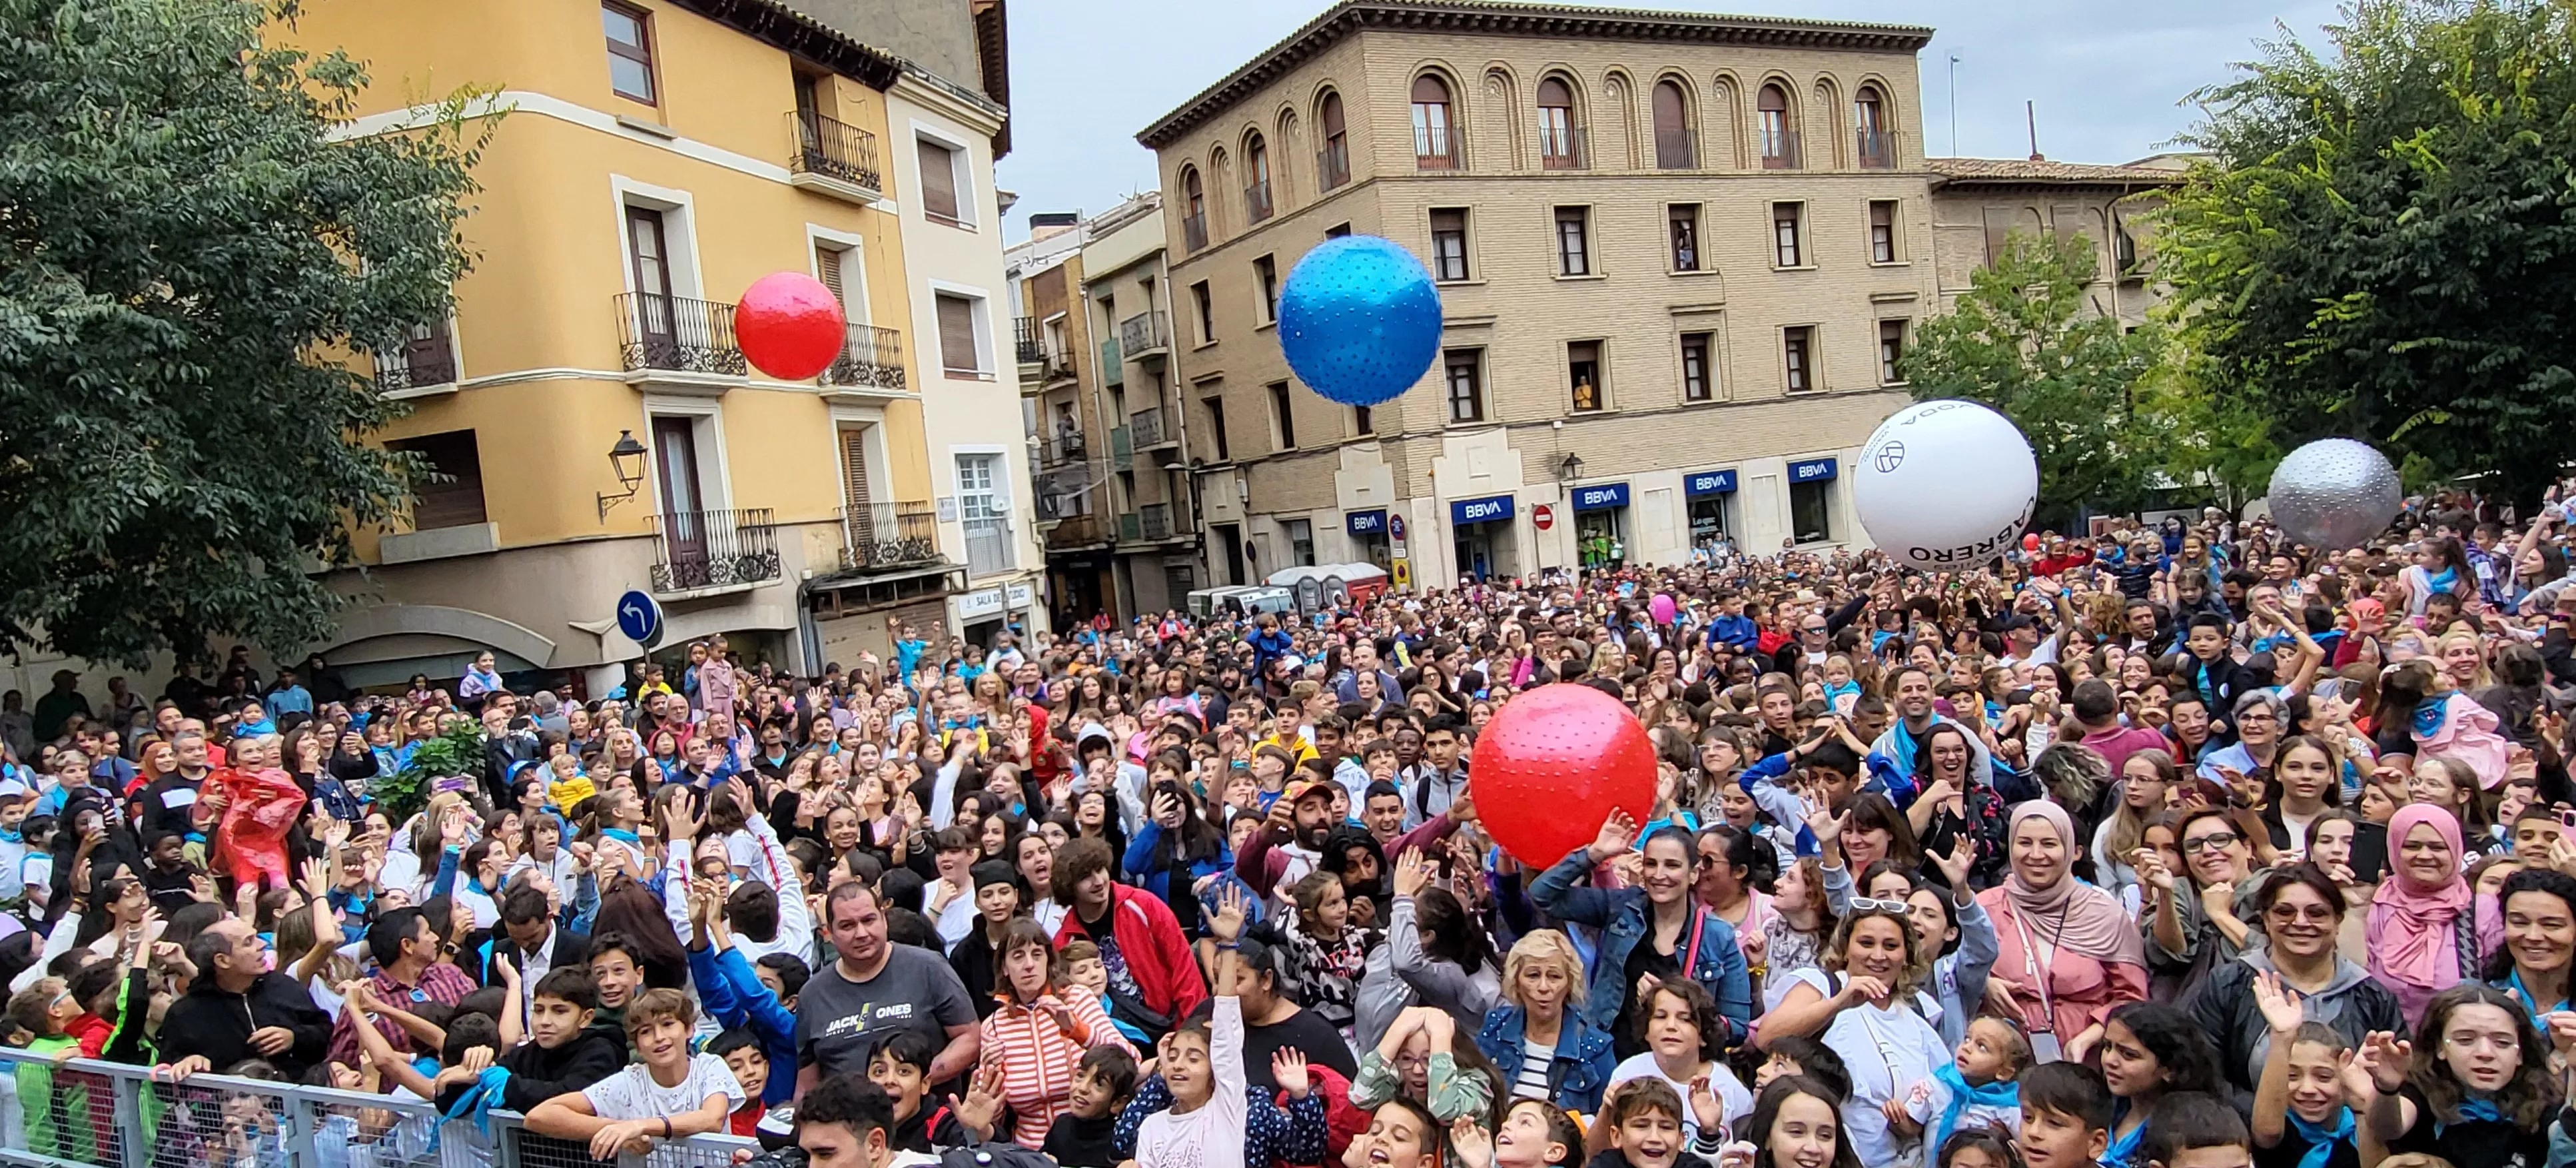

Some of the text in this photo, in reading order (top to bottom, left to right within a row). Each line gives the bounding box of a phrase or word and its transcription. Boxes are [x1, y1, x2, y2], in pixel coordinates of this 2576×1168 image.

[1799, 462, 1827, 478] BBVA
[1696, 474, 1727, 490] BBVA
[1584, 488, 1617, 504] BBVA
[1466, 501, 1502, 518] BBVA
[1354, 514, 1378, 530] BBVA
[826, 1014, 859, 1033] JACK
[876, 1003, 912, 1019] ONES
